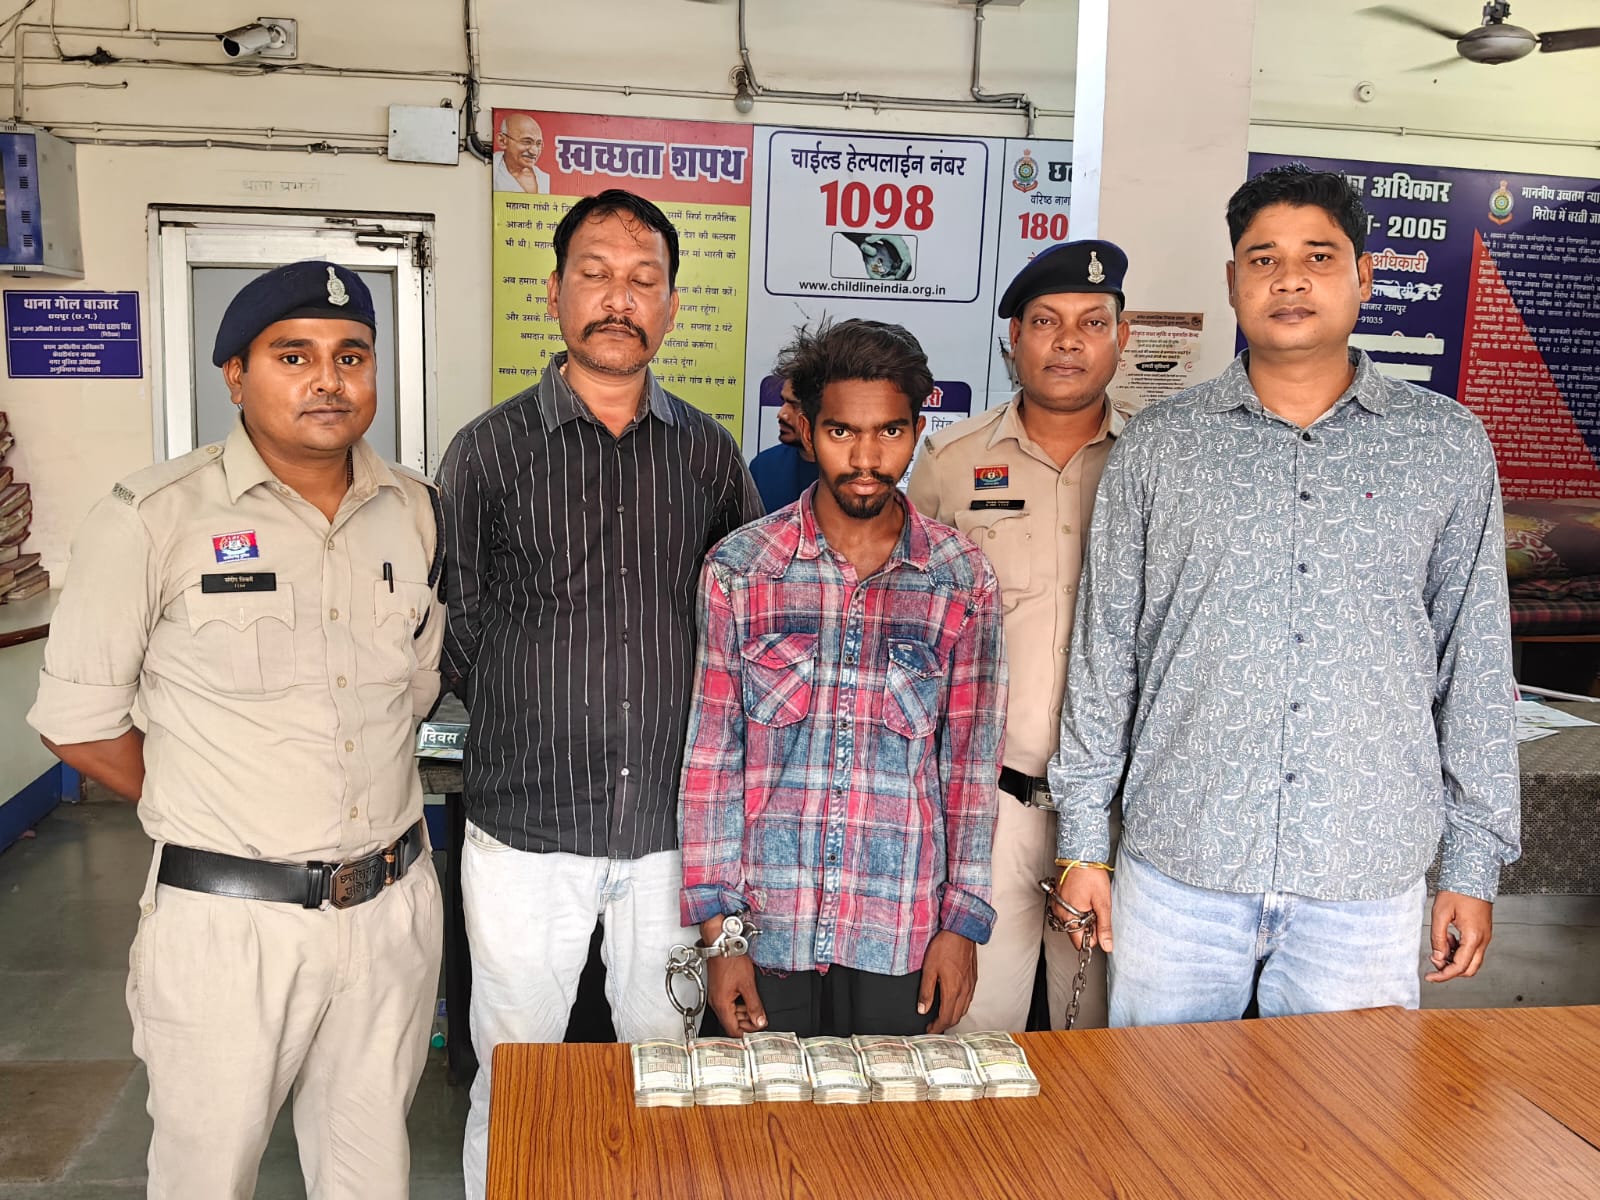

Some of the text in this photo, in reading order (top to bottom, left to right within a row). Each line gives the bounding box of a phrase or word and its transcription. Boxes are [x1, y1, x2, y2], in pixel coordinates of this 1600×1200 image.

[556, 138, 746, 182] स्वच्छता शपथ
[791, 141, 967, 179] चाईल्ड हेल्पलाईन नंबर
[1370, 172, 1453, 203] अधिकार
[1521, 185, 1555, 201] माननीय
[1587, 191, 1600, 204] न्या
[820, 180, 934, 231] 1098
[1532, 205, 1557, 221] निरोध
[1558, 207, 1568, 222] में
[1387, 215, 1447, 240] 2005
[1373, 249, 1428, 273] अधिकारी
[799, 280, 946, 297] www.childlineindia.org.in
[23, 296, 120, 310] थाना गोल बाजार
